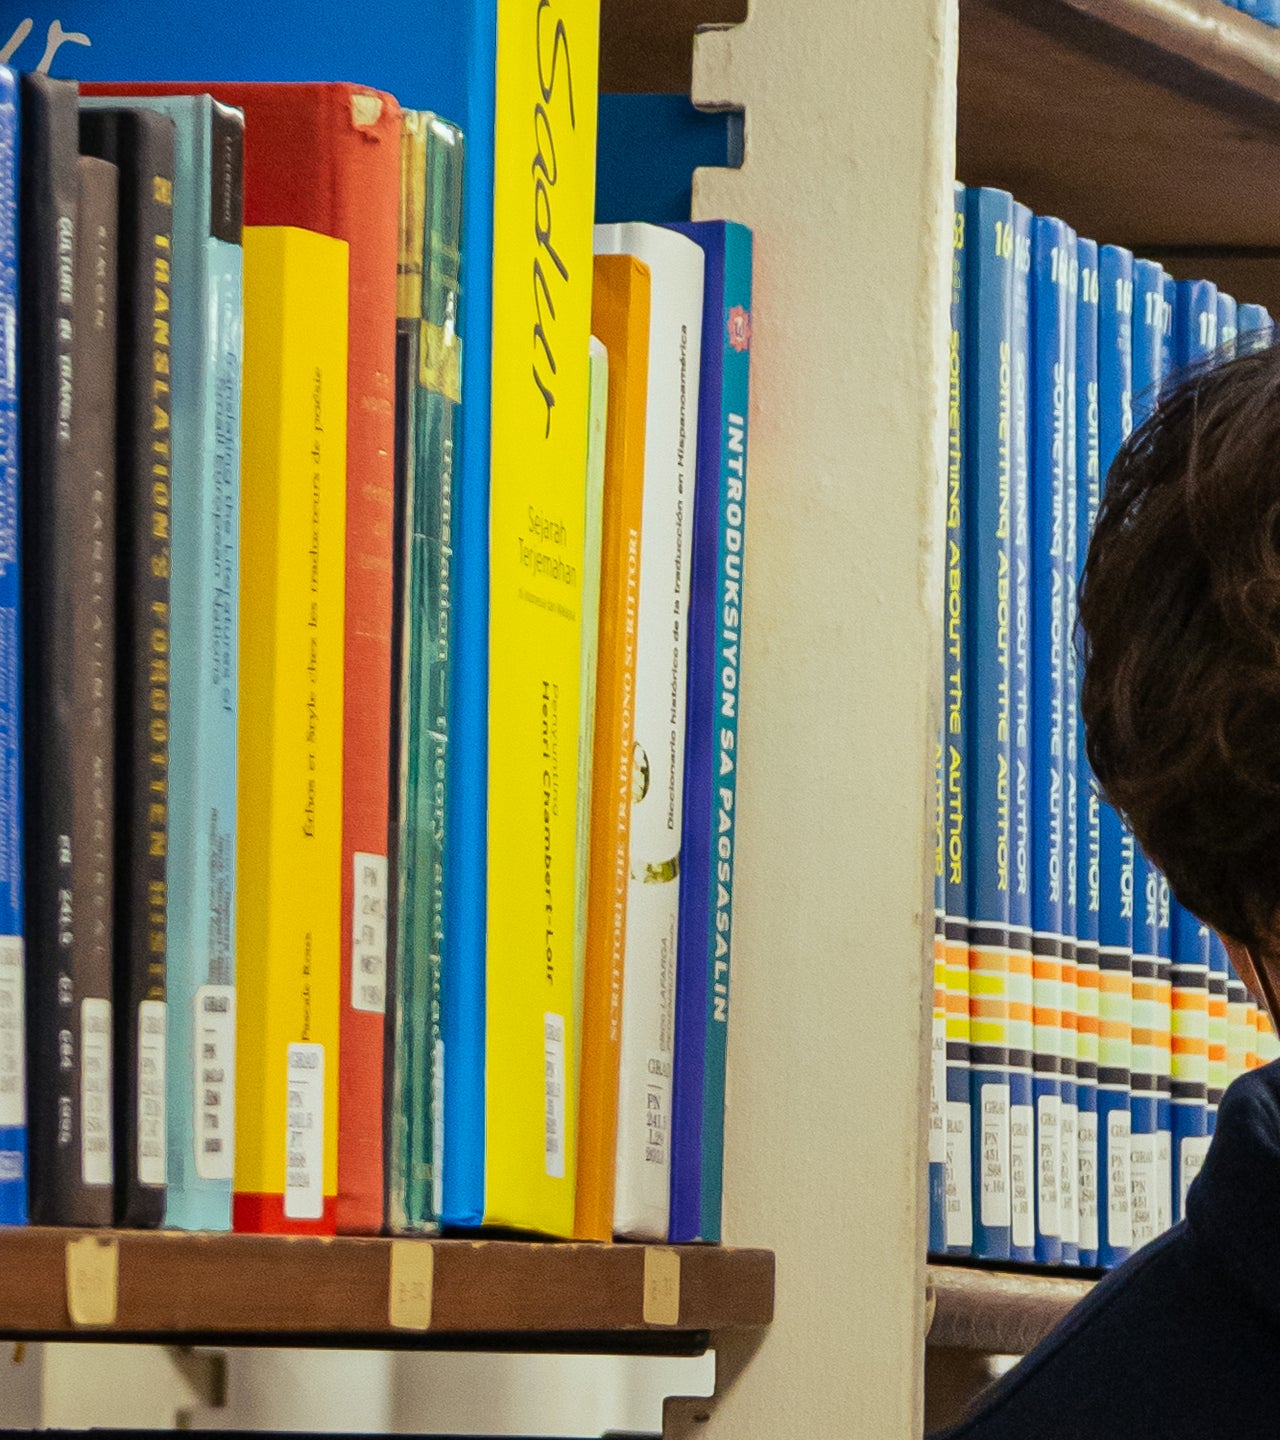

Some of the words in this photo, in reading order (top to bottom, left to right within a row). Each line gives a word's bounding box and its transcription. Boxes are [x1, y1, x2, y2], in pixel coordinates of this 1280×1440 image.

[60, 216, 76, 303] CULTURE
[676, 324, 688, 468] Hispanoamérica
[528, 505, 567, 548] Sejarah
[677, 473, 685, 495] en
[518, 537, 577, 588] Terjemahan
[673, 499, 685, 594] traducción
[722, 412, 745, 717] INTRODUKSIYON
[624, 529, 639, 667] SCRITTORI
[672, 621, 680, 643] de
[673, 600, 681, 616] la
[542, 680, 551, 758] Henri
[669, 647, 679, 725] histórico
[551, 683, 560, 817] Penyunting
[666, 730, 677, 830] Diccionario
[719, 727, 735, 775] SA
[543, 769, 555, 986] Chambert-Loir
[714, 787, 735, 1022] PAGSASALIN
